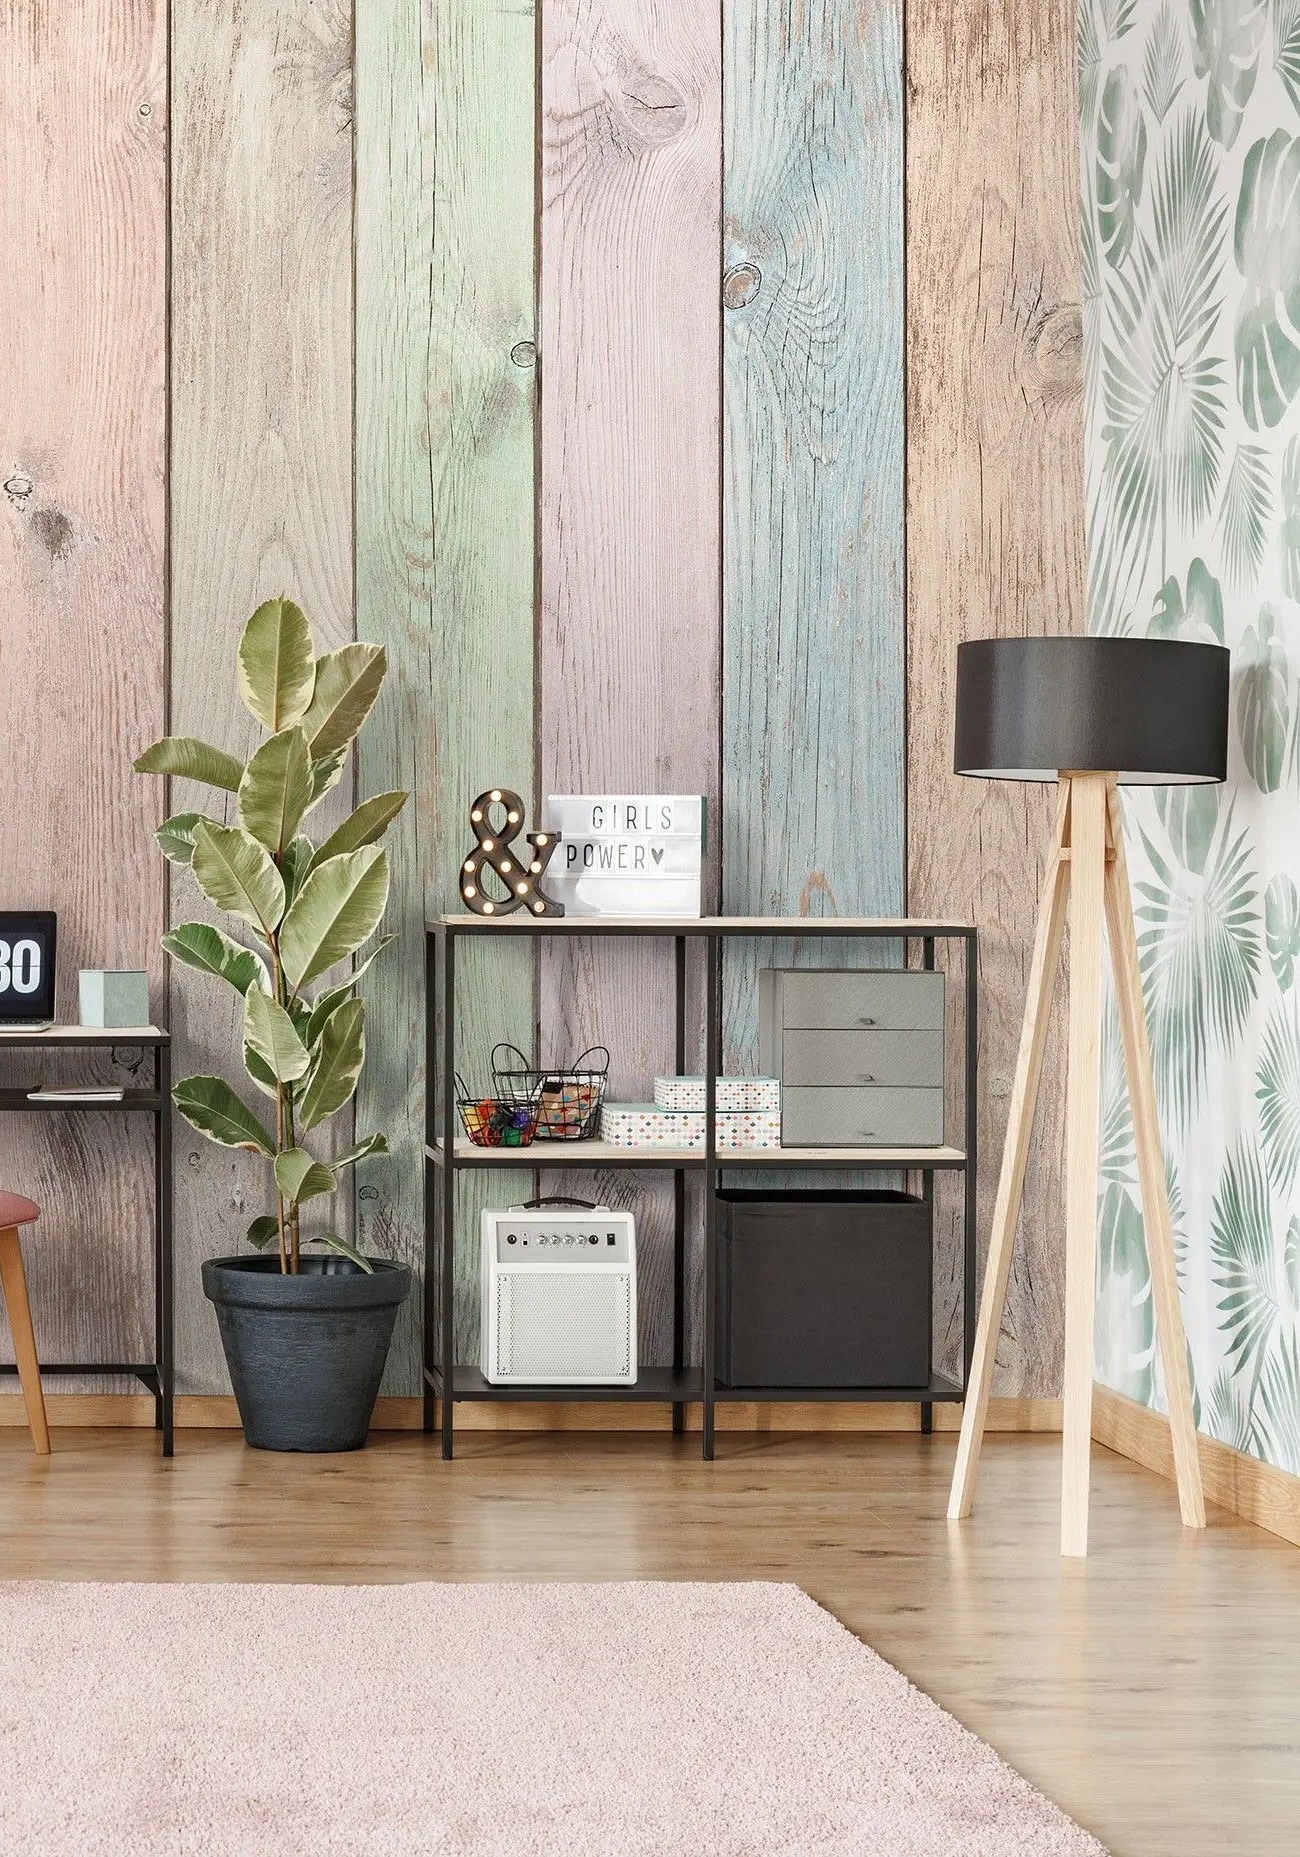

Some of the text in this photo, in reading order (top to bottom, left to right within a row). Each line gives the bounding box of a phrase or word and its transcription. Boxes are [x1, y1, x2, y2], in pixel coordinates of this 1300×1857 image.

[592, 805, 672, 830] GIRLS
[459, 788, 565, 917] &
[566, 843, 645, 869] POWER
